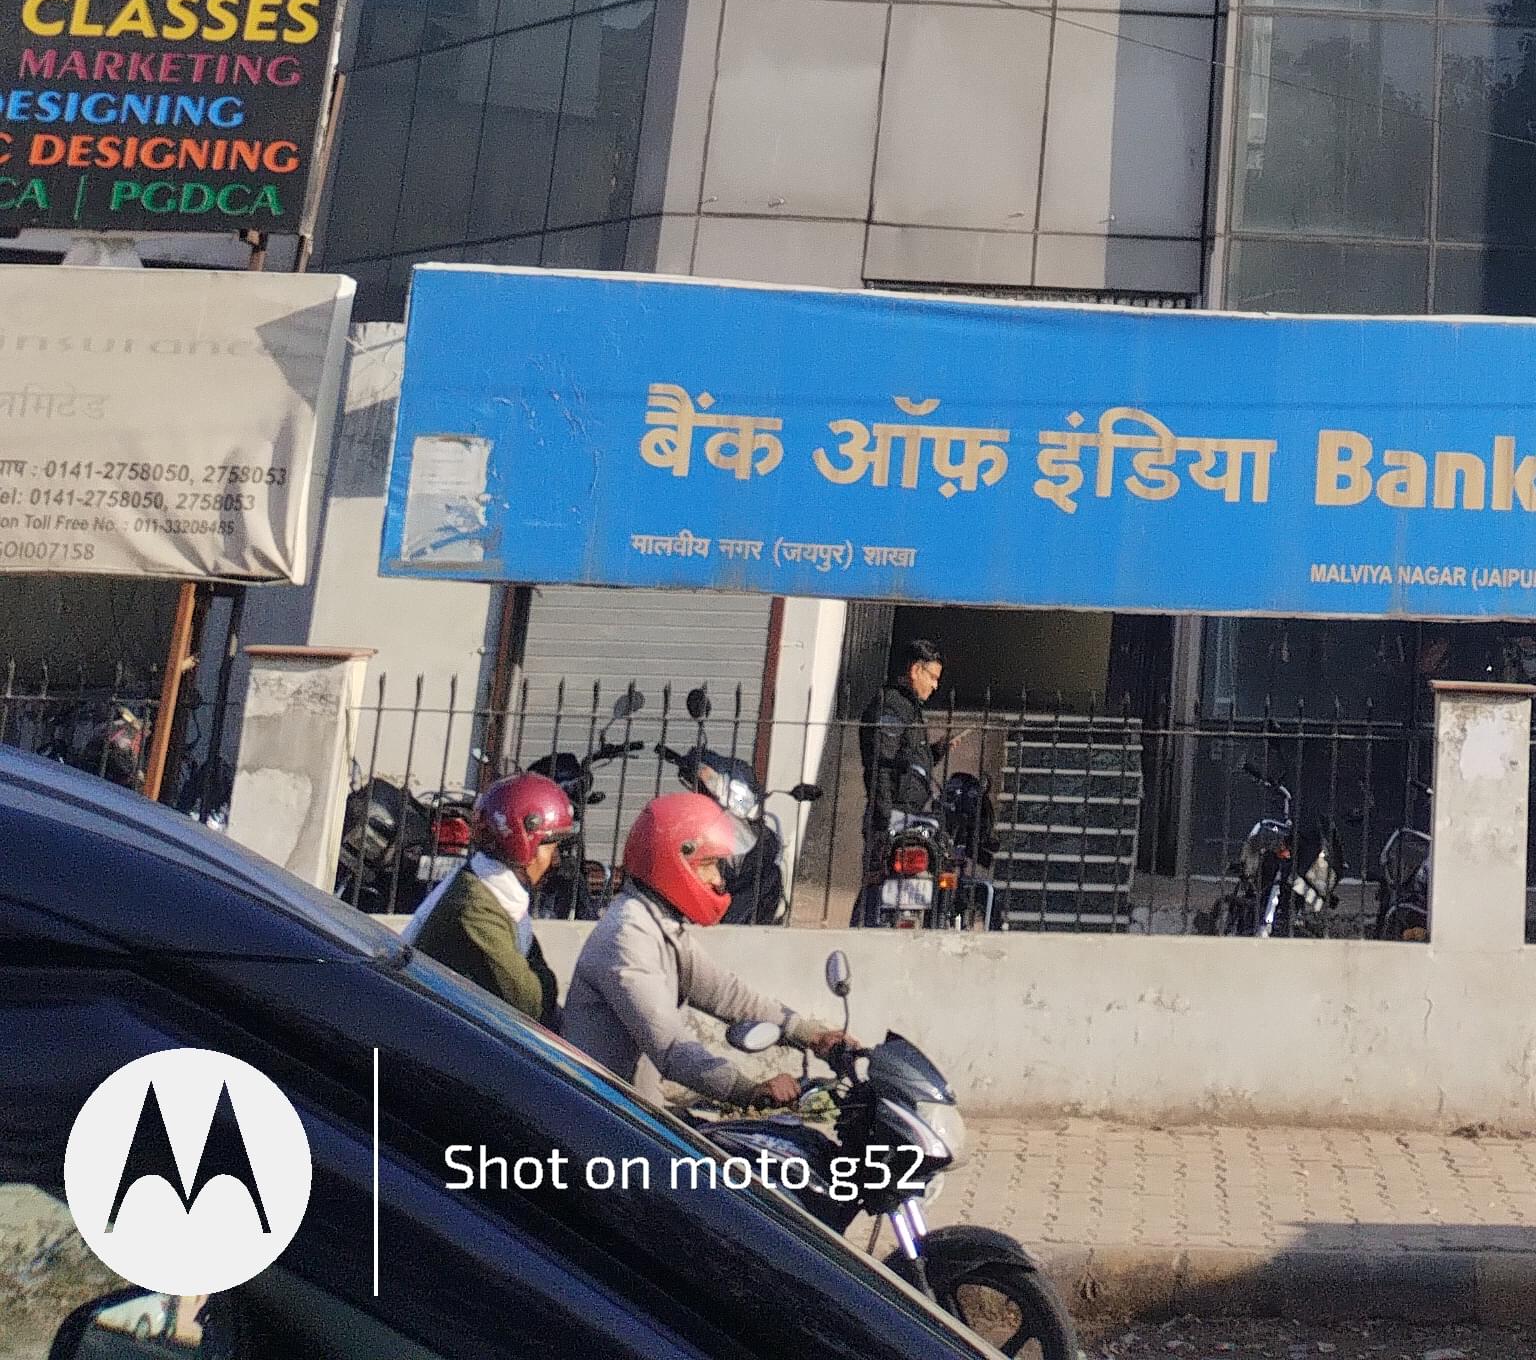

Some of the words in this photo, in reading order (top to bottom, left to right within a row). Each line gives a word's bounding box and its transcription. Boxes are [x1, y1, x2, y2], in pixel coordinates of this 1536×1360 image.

[19, 48, 301, 86] MARKETING
[0, 89, 244, 128] ESIGNING
[28, 133, 299, 174] DESIGNING
[110, 179, 283, 216] PGDCA
[640, 383, 784, 480] बैंक
[1033, 407, 1277, 514] इंडिया
[43, 459, 194, 486] 0141-2758050,
[30, 487, 168, 512] 0141-2758050,
[175, 492, 256, 511] 2758053
[25, 513, 50, 530] Toll
[55, 515, 89, 531] Free
[631, 529, 711, 558] मालवीय
[719, 539, 764, 560] नगर
[773, 536, 853, 572] (जयपुर)
[863, 546, 917, 568] शाखा
[1310, 564, 1393, 584] MALVIYA
[1397, 566, 1466, 586] NAGAR
